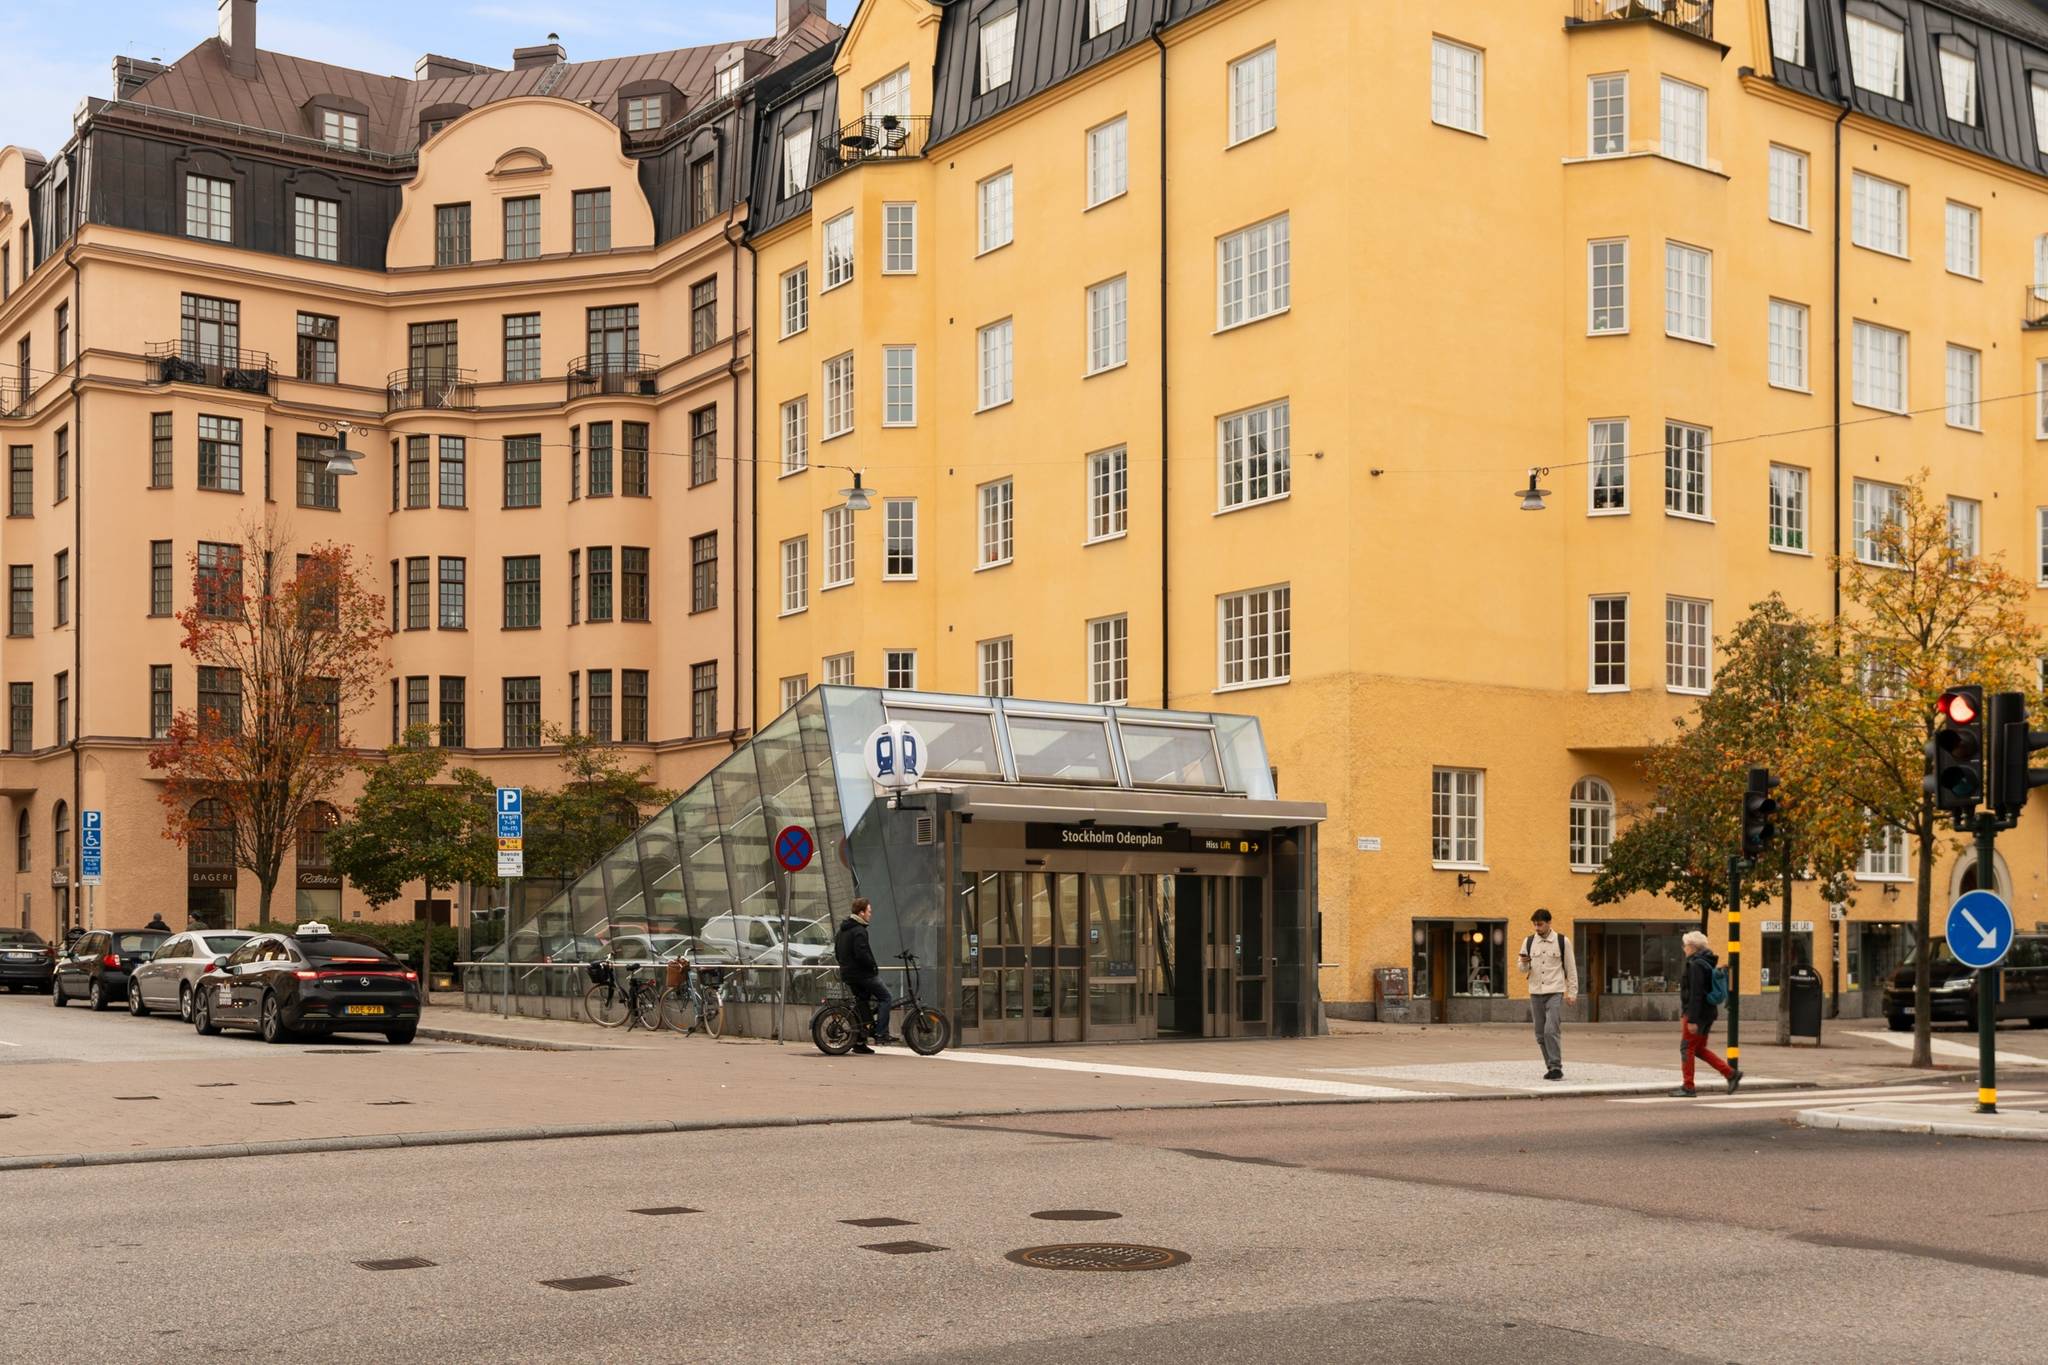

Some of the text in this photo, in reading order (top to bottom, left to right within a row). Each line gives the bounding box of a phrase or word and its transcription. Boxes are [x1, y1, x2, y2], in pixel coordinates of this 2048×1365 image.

[503, 791, 517, 811] P
[87, 812, 99, 828] P
[1061, 830, 1163, 847] Stockholm Odenplan
[1205, 840, 1231, 849] Hiss Lift
[192, 872, 233, 882] BAGERI
[300, 872, 340, 884] Ritorno
